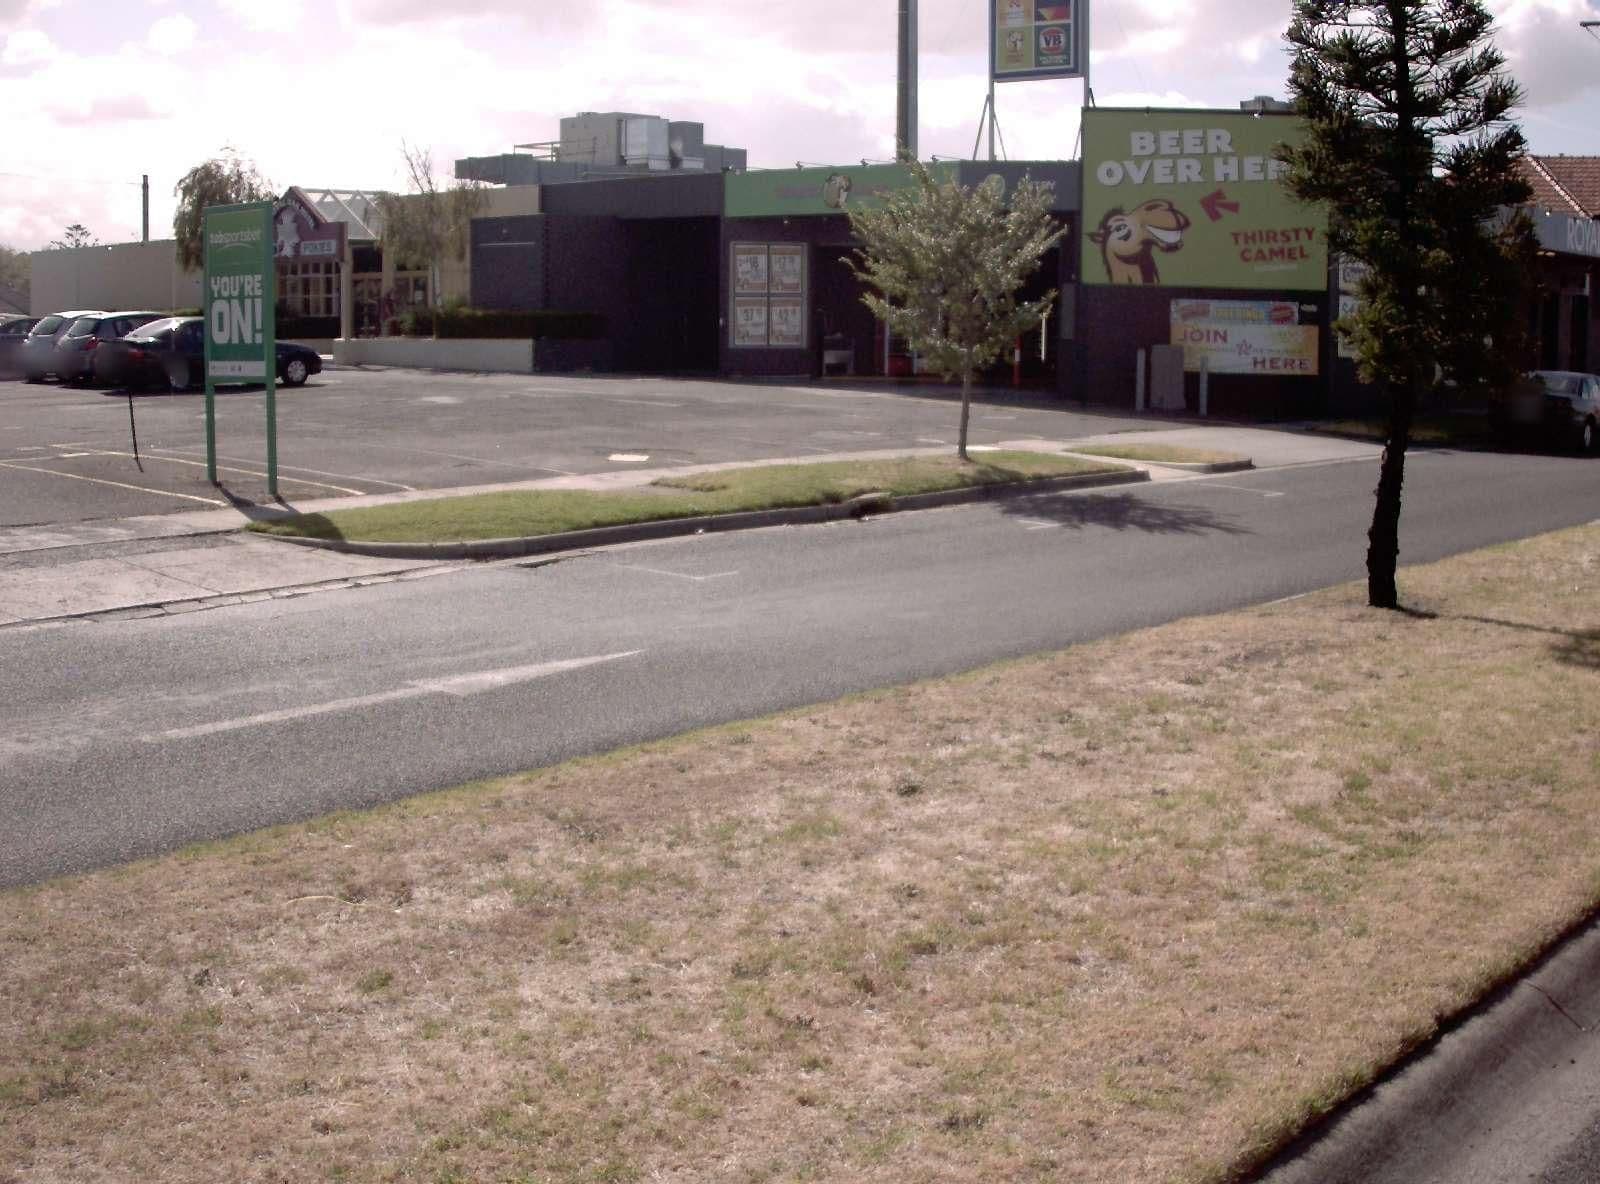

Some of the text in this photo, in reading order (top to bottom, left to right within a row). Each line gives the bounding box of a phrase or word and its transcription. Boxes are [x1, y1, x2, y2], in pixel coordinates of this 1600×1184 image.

[1043, 33, 1064, 47] VB
[1131, 129, 1234, 155] BEER
[1097, 157, 1204, 186] OVER
[1231, 227, 1316, 246] THIRSTY
[1240, 245, 1310, 263] CAMEL
[211, 274, 263, 297] YOU'RE
[211, 298, 263, 344] ON!
[1178, 328, 1228, 344] JOIN
[1253, 357, 1312, 370] HERE
